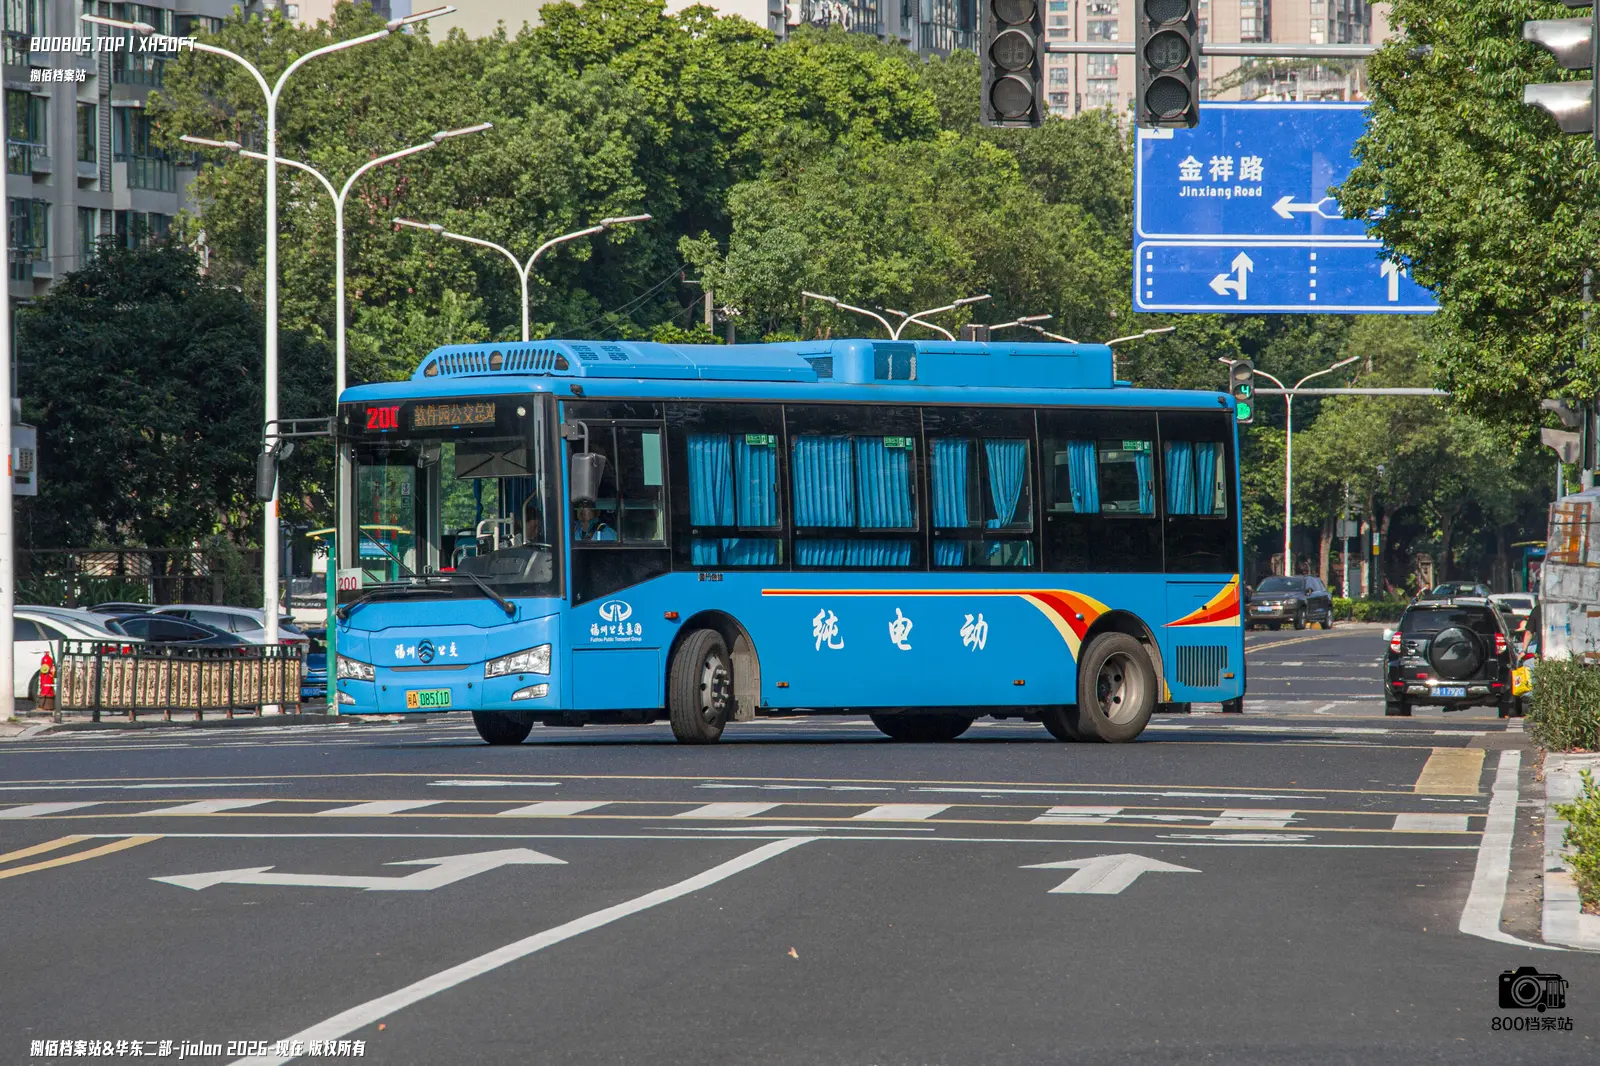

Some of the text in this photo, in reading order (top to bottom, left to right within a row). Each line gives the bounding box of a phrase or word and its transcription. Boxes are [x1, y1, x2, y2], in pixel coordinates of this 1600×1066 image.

[1178, 155, 1265, 182] 金祥路
[1179, 185, 1263, 199] Jinxiang Road
[1241, 385, 1250, 398] 4
[339, 576, 357, 591] 200
[590, 622, 643, 637] 福州公交集团
[812, 607, 988, 652] 纯电动
[395, 641, 459, 659] 福州 公交
